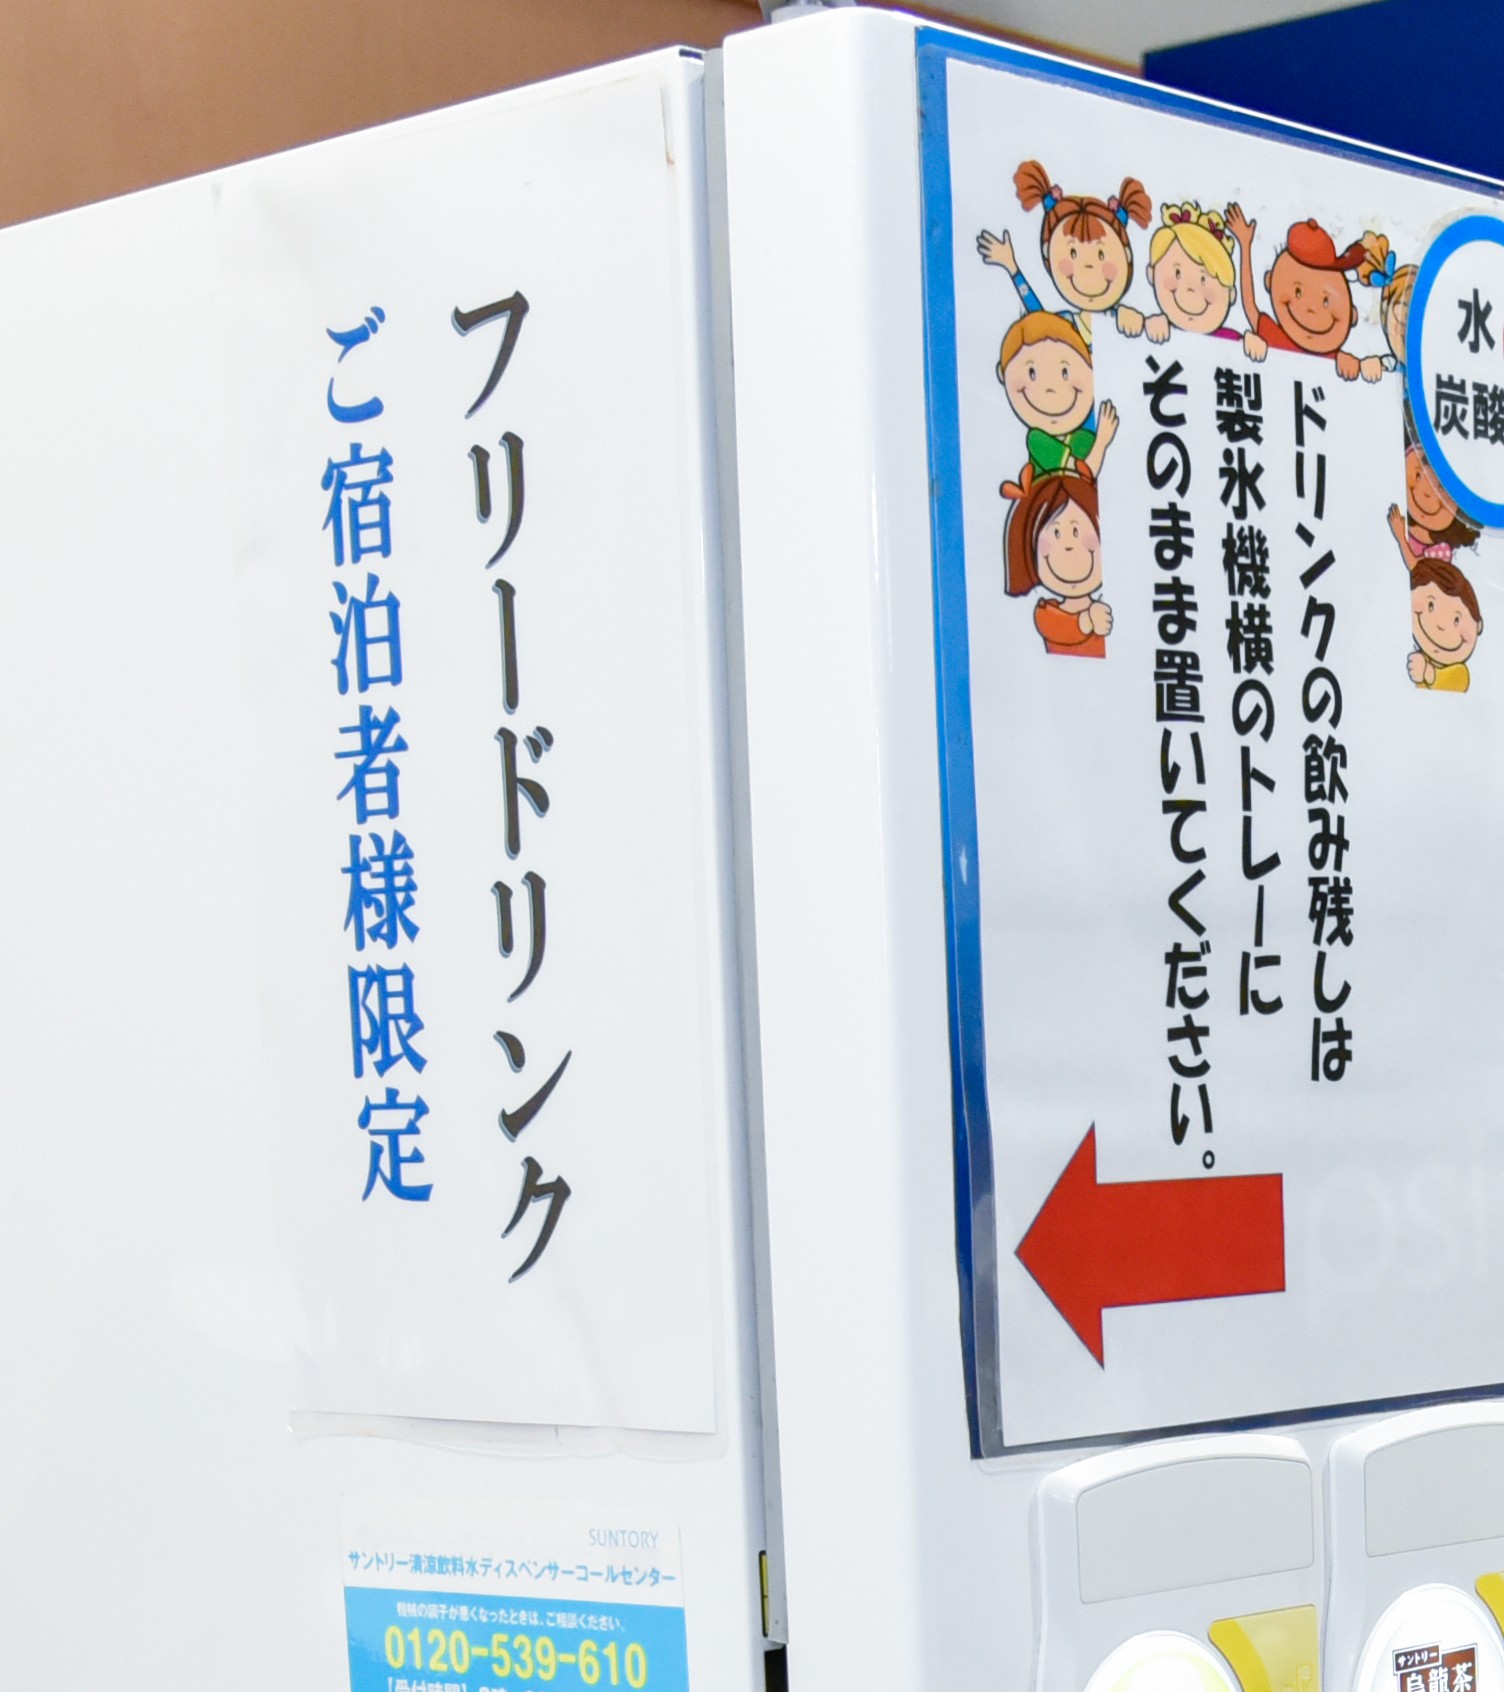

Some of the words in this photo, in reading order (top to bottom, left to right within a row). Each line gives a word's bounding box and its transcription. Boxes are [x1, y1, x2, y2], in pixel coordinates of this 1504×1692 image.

[1457, 287, 1495, 355] 水
[321, 305, 434, 1204] ご宿泊者様限定
[451, 291, 573, 1284] フリードリンク
[1141, 353, 1217, 1171] そのまま置いてください。
[1214, 367, 1284, 1017] 製氷機横のトレーに
[1293, 380, 1355, 1083] ドリンクの飲み残しは
[385, 1625, 649, 1690] 0120-539-610
[588, 1528, 660, 1549] SUNTORY
[1397, 1649, 1438, 1668] サントリー
